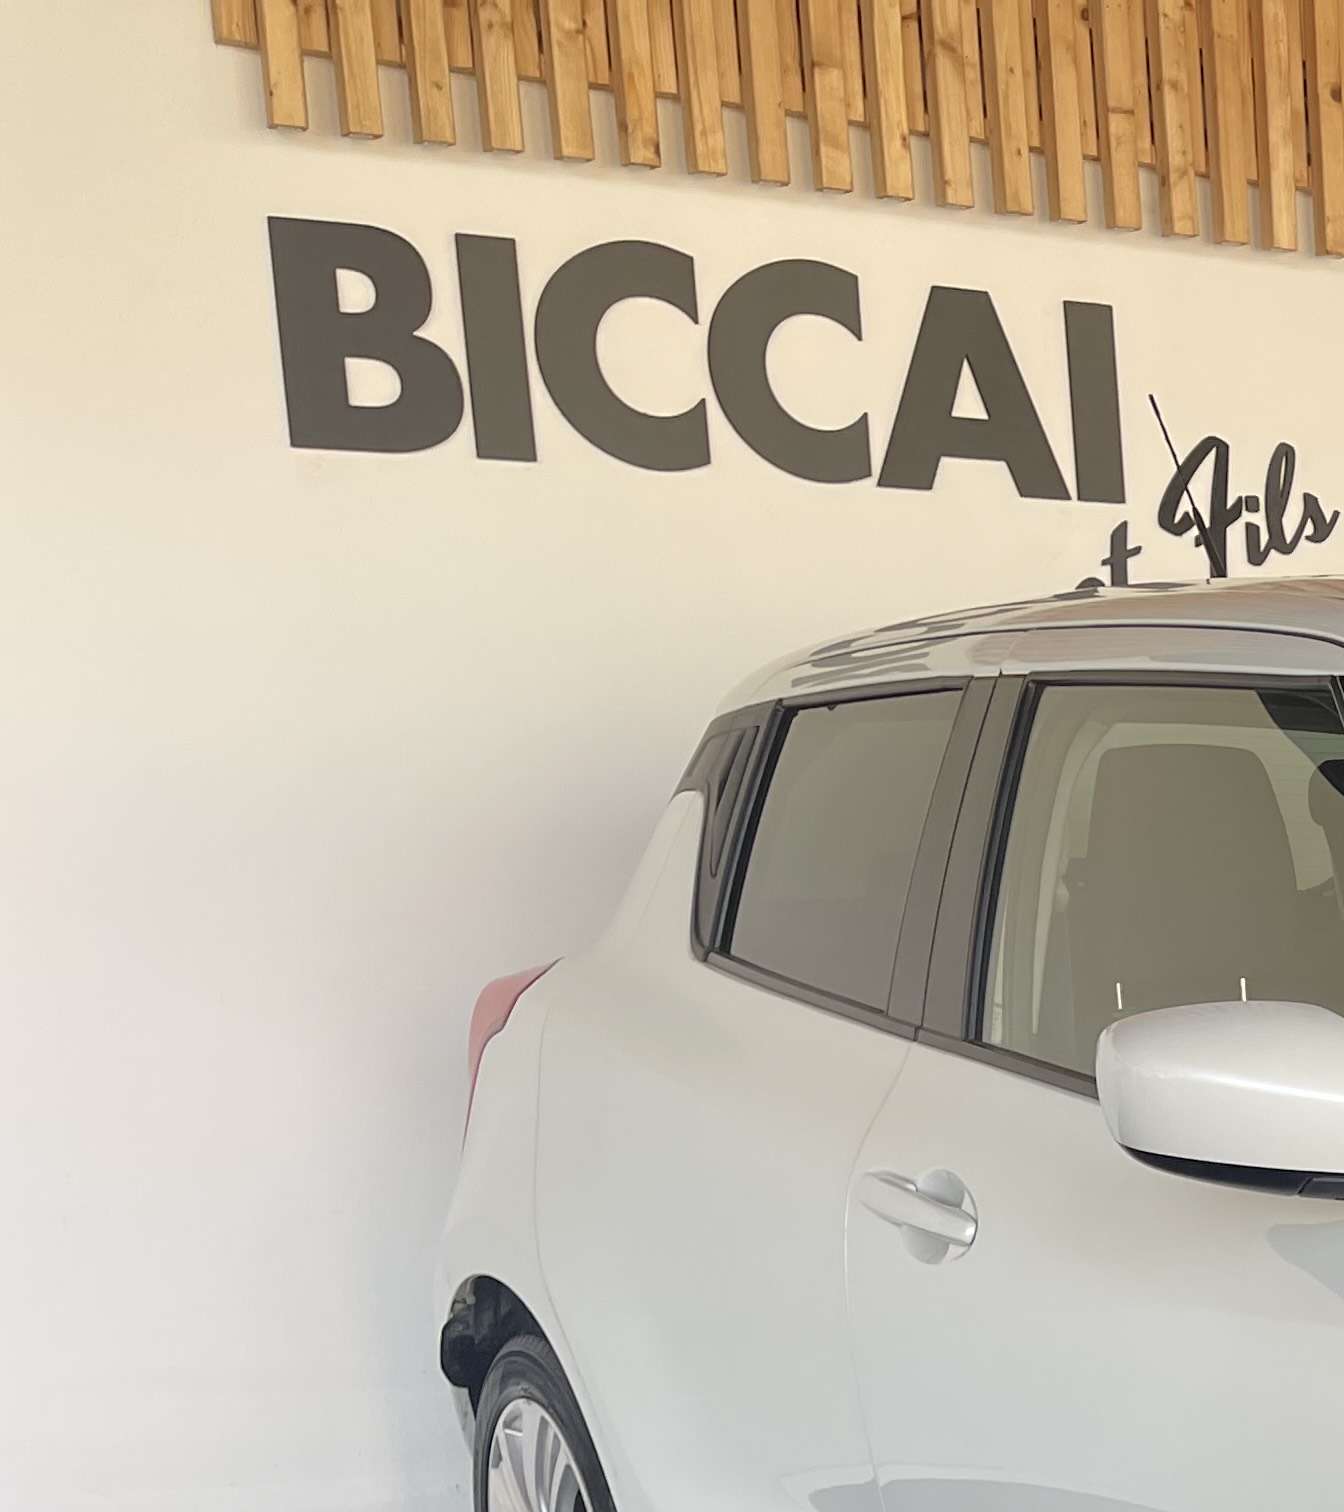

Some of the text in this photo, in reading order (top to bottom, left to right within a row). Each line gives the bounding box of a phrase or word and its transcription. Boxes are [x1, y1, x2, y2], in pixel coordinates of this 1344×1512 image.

[266, 215, 1127, 505] BICCAI
[1075, 435, 1341, 588] t Fils
